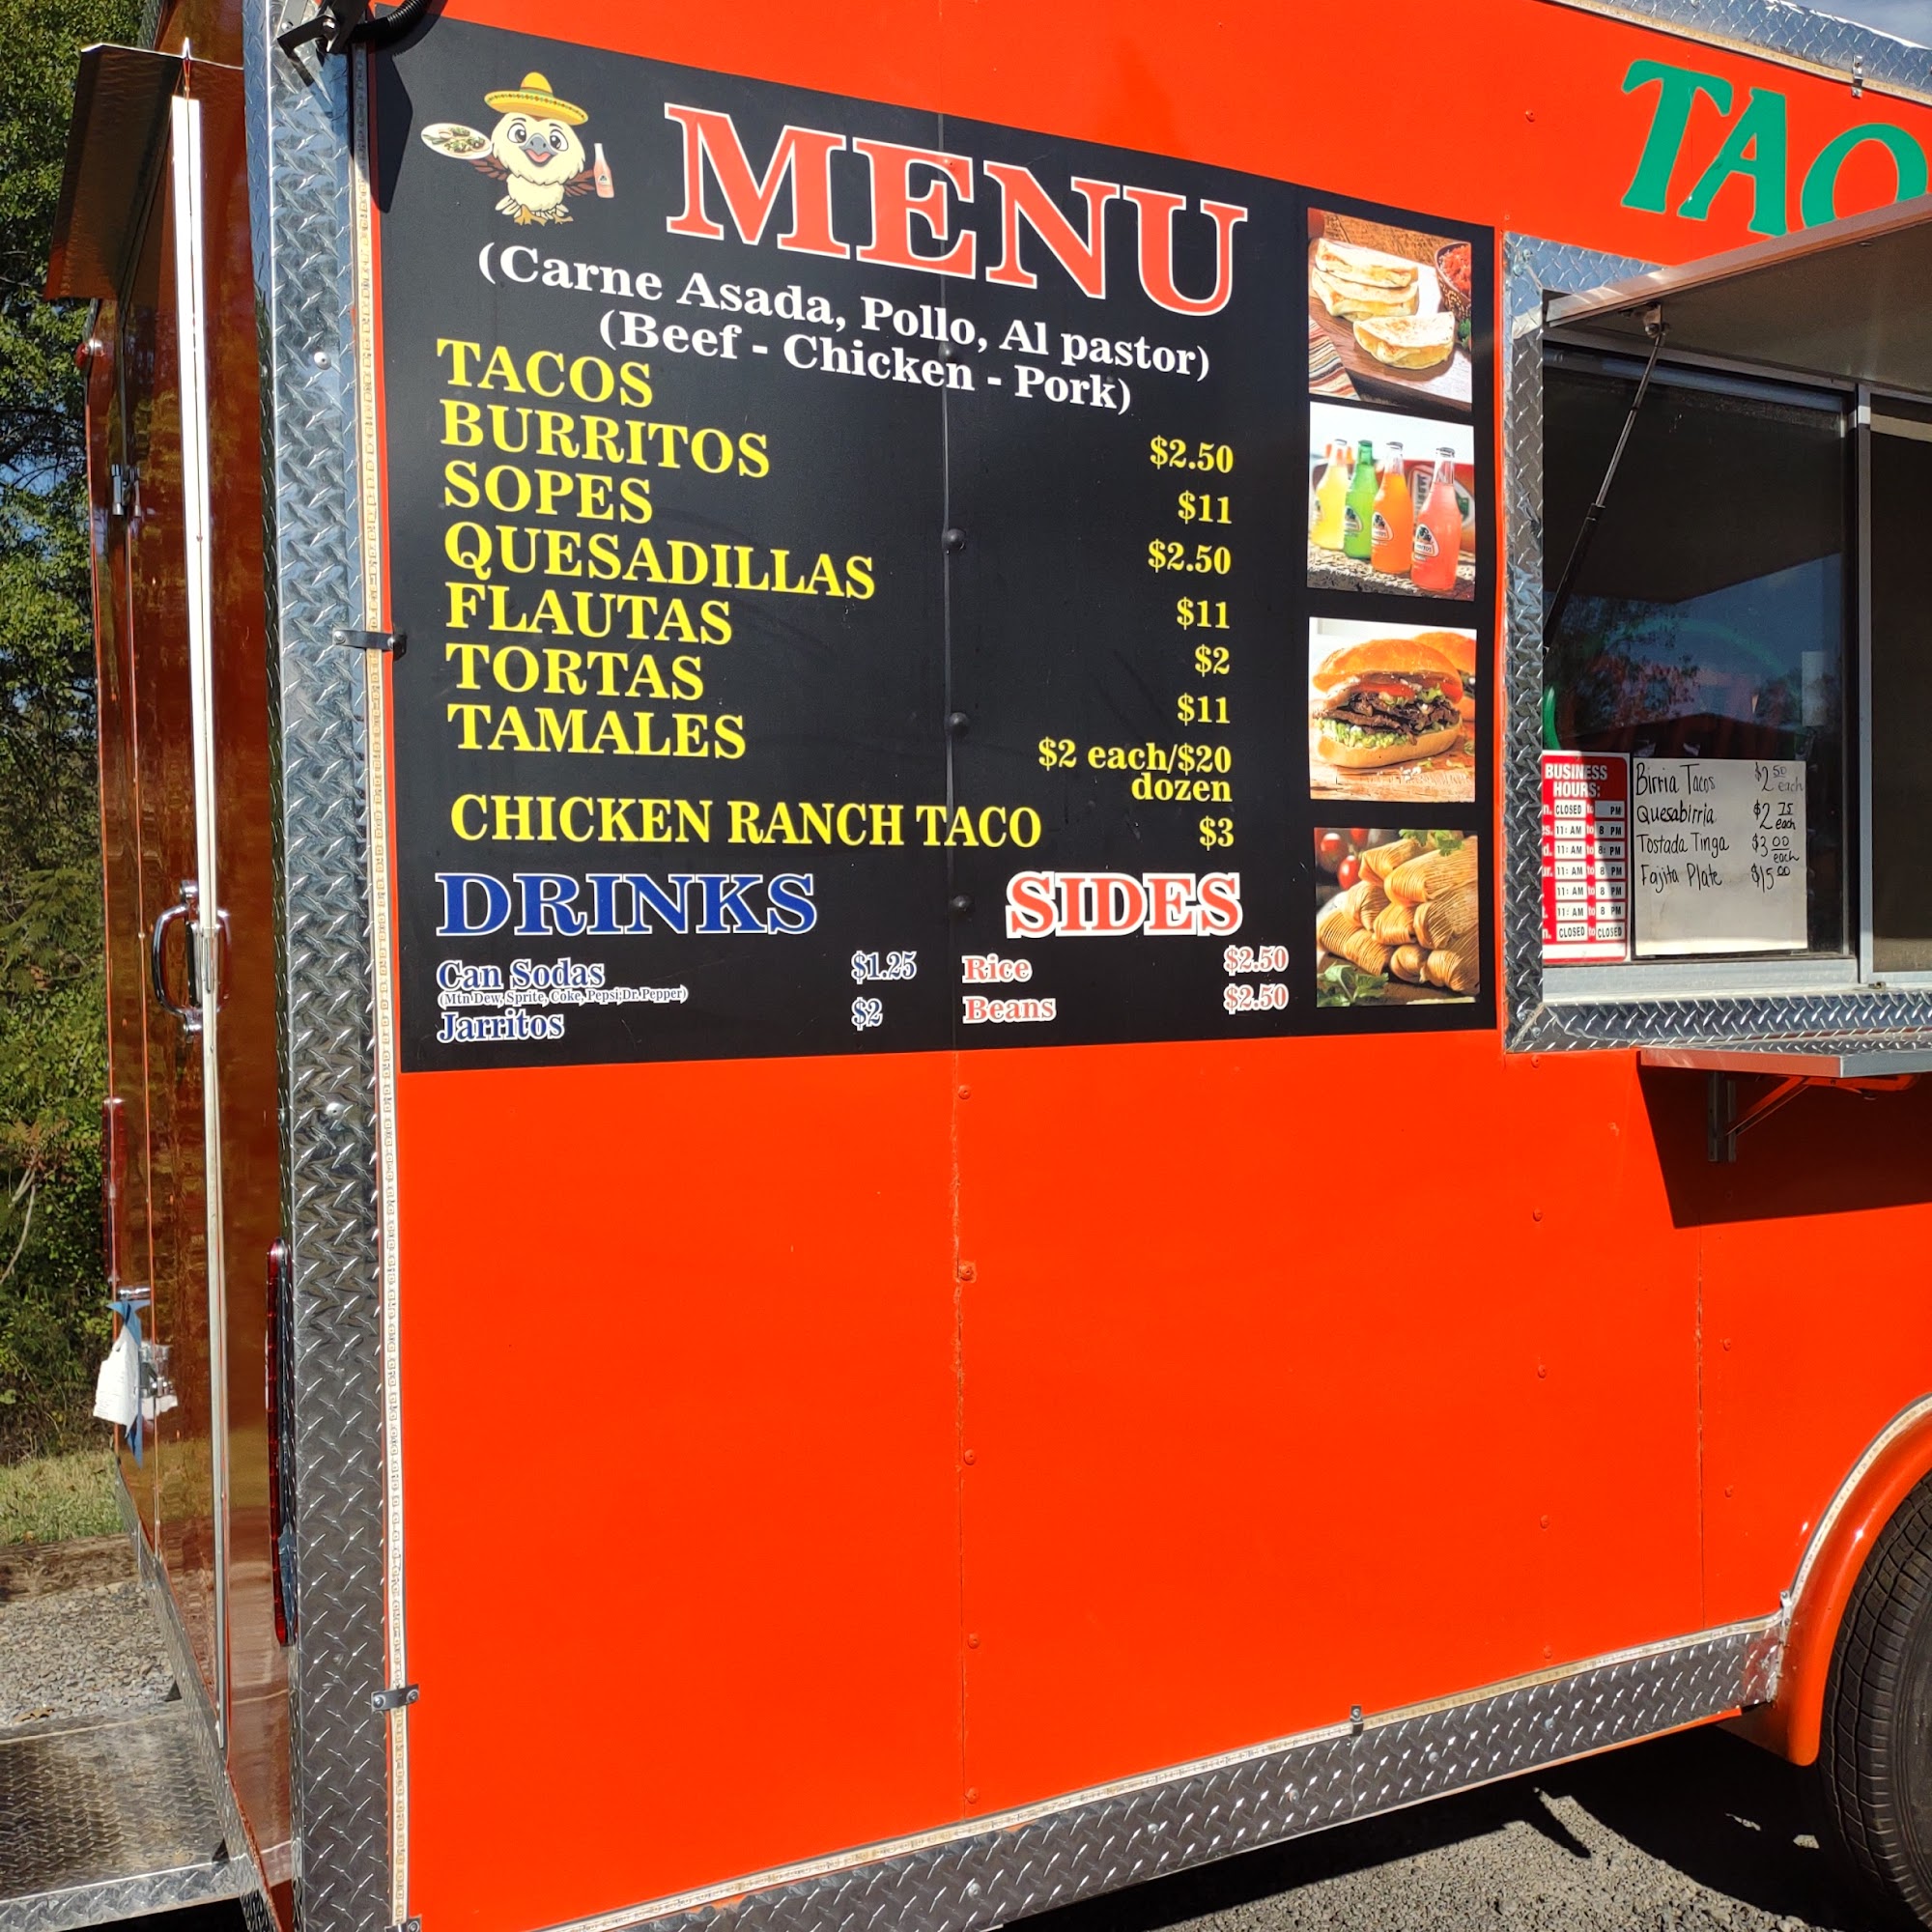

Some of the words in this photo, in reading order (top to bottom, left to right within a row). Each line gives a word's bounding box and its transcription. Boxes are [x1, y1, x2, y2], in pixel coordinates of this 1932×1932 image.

[664, 101, 1248, 317] MENU
[478, 242, 663, 301] (Carne
[676, 272, 846, 332] Asada,
[861, 297, 988, 353] Pollo,
[999, 320, 1048, 355] Al
[1061, 333, 1209, 382] pastor)
[437, 338, 653, 408] TACOS
[600, 309, 742, 361] (Beef
[783, 334, 976, 392] Chicken
[1014, 365, 1131, 415] Pork)
[440, 399, 770, 478] BURRITOS
[1150, 436, 1234, 473] $2.50
[443, 460, 654, 524] SOPES
[1177, 491, 1232, 525] $11
[444, 522, 875, 599] QUESADILLAS
[1148, 539, 1232, 575] $2.50
[445, 582, 733, 645] FLAUTAS
[1176, 596, 1231, 630] $11
[445, 642, 705, 700] TORTAS
[1194, 644, 1231, 675] $2
[1177, 695, 1231, 724] $11
[447, 703, 747, 758] TAMALES
[1038, 736, 1077, 771] $2
[1131, 772, 1233, 802] dozen
[1546, 763, 1607, 781] BUSINESS
[1635, 762, 1679, 795] Birria
[1680, 763, 1716, 795] Tacos
[1777, 777, 1804, 792] each
[1553, 781, 1601, 797] HOURS:
[451, 794, 714, 843] CHICKEN
[726, 800, 904, 846] RANCH
[916, 804, 1042, 847] TACO
[1556, 805, 1582, 815] CLOSED
[1586, 804, 1594, 814] to
[1610, 807, 1621, 815] PM
[1636, 800, 1715, 827] Quesabirria
[1776, 817, 1796, 830] each
[1199, 815, 1235, 851] $3
[1570, 825, 1582, 835] AM
[1586, 825, 1594, 834] to
[1610, 827, 1622, 836] PM
[1571, 845, 1582, 854] AM
[1586, 845, 1594, 854] to
[1609, 847, 1621, 856] PM
[1636, 834, 1688, 854] Tostada
[1690, 833, 1729, 859] Tinga
[1774, 851, 1800, 863] each
[1571, 867, 1583, 875] AM
[1587, 866, 1595, 874] to
[1610, 867, 1622, 875] PM
[1641, 865, 1680, 893] Fajita
[1687, 863, 1722, 891] Plate
[435, 873, 818, 936] DRINKS
[1006, 871, 1243, 939] SIDES
[1572, 887, 1583, 895] AM
[1587, 886, 1595, 895] to
[1610, 887, 1622, 895] PM
[1572, 907, 1583, 917] AM
[1588, 906, 1596, 915] to
[1610, 906, 1622, 915] PM
[1559, 926, 1585, 938] CLOSED
[1588, 927, 1596, 936] to
[1597, 927, 1623, 938] CLOSED
[437, 960, 504, 991] Can
[510, 957, 606, 989] Sodas
[851, 951, 917, 983] $1.25
[962, 953, 1033, 983] Rice
[1224, 945, 1289, 976] $2.50
[438, 989, 473, 1009] (Mtn
[474, 989, 504, 1009] Dew,
[505, 988, 549, 1008] Sprite,
[550, 988, 584, 1007] Coke,
[641, 985, 689, 1004] Pepper)
[851, 997, 883, 1030] $2
[963, 996, 1056, 1024] Beans
[1224, 983, 1289, 1015] $2.50
[437, 1008, 565, 1043] Jarritos
